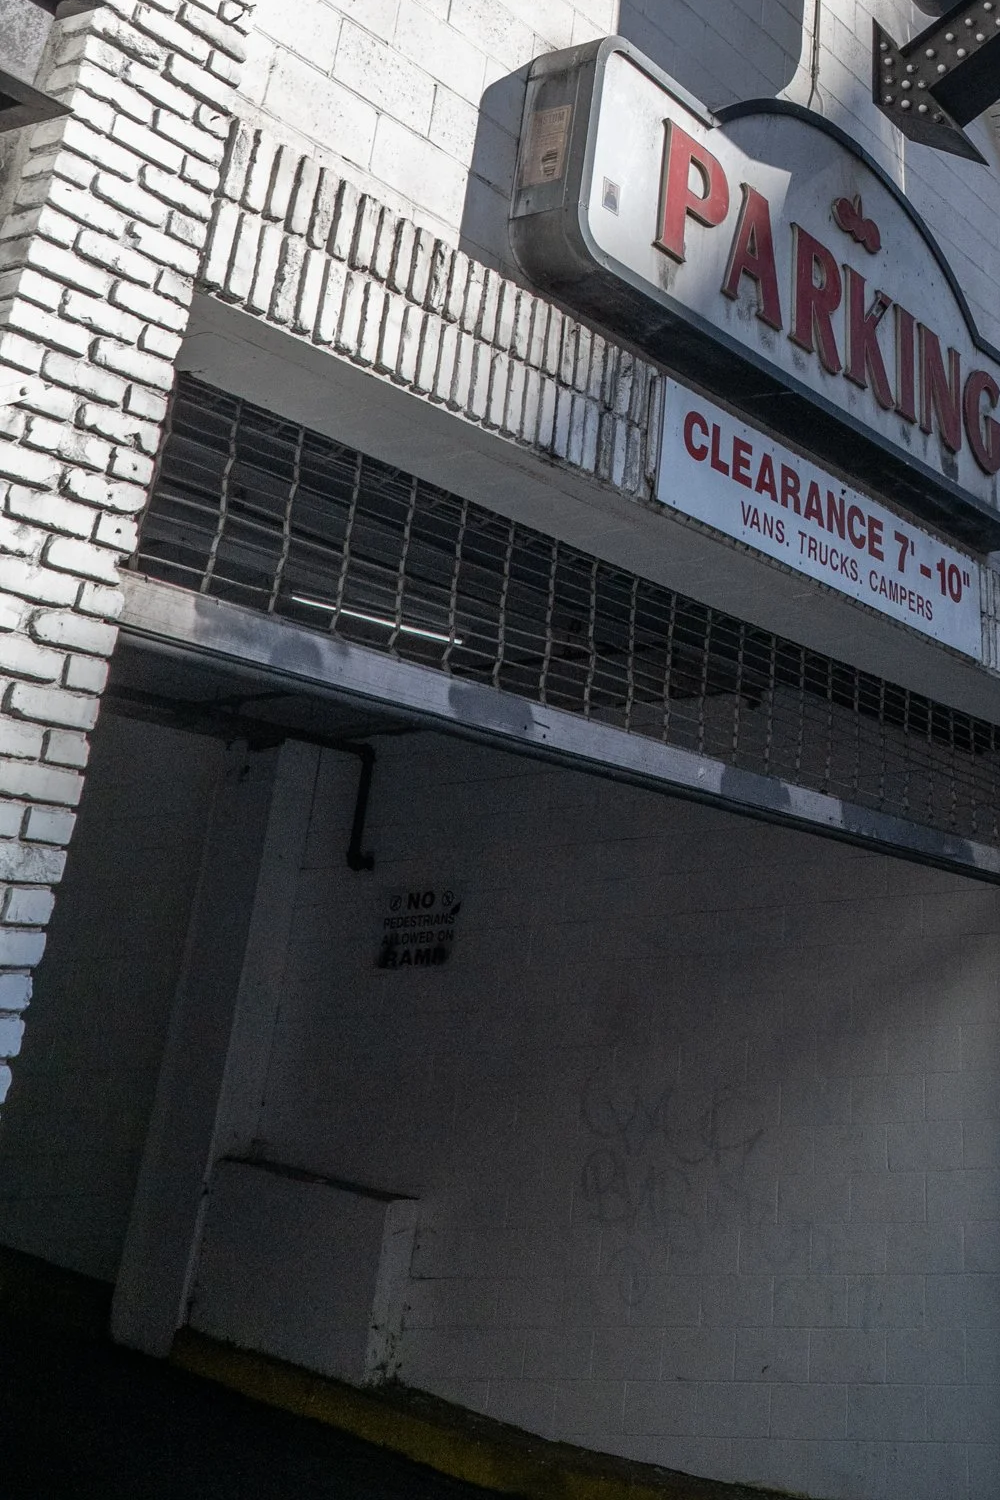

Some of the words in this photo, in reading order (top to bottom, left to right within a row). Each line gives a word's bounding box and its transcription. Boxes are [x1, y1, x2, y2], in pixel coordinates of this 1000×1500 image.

[682, 411, 884, 563] CLEARANCE
[869, 569, 934, 622] CAMPERS
[407, 891, 436, 910] NO
[383, 913, 455, 930] PEDESTRIANS
[381, 931, 434, 947] ALLOWED
[437, 929, 455, 942] ON
